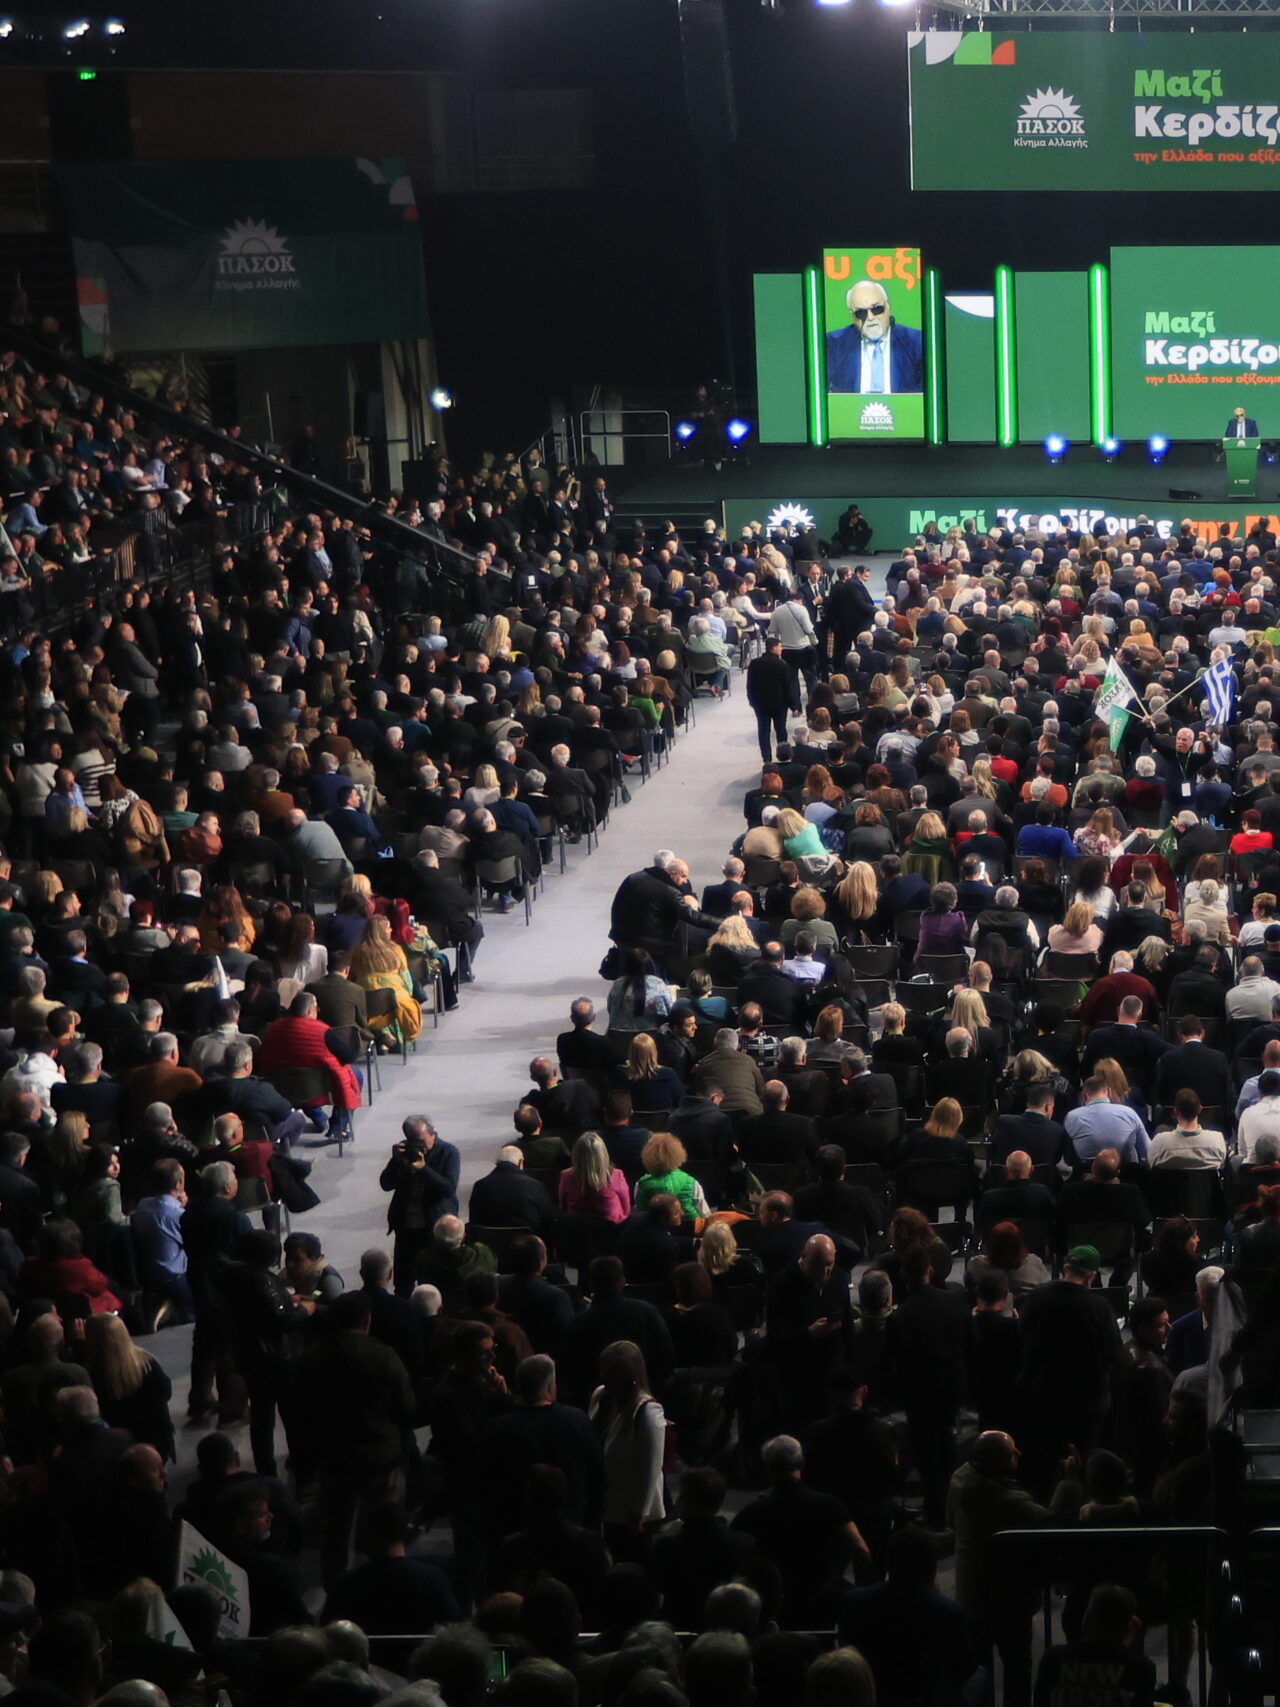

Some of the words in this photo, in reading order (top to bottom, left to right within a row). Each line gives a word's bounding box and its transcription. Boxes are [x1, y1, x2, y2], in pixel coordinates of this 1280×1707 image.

[1134, 69, 1223, 104] Μαζί
[1016, 119, 1086, 134] ΠΑΣΟΚ
[1014, 138, 1046, 149] Κίνημα
[1048, 138, 1089, 149] Αλλαγής
[1134, 153, 1157, 164] την
[1162, 149, 1214, 162] Ελλάδα
[1218, 153, 1244, 162] που
[218, 255, 296, 274] ΠΑΣΟΚ
[1145, 311, 1216, 338] Μαζί
[1145, 375, 1166, 386] την
[1167, 373, 1209, 384] Ελλάδα
[1211, 375, 1233, 384] που
[996, 508, 1174, 540] Κερδίζουε
[1059, 1662, 1127, 1684] NEW
